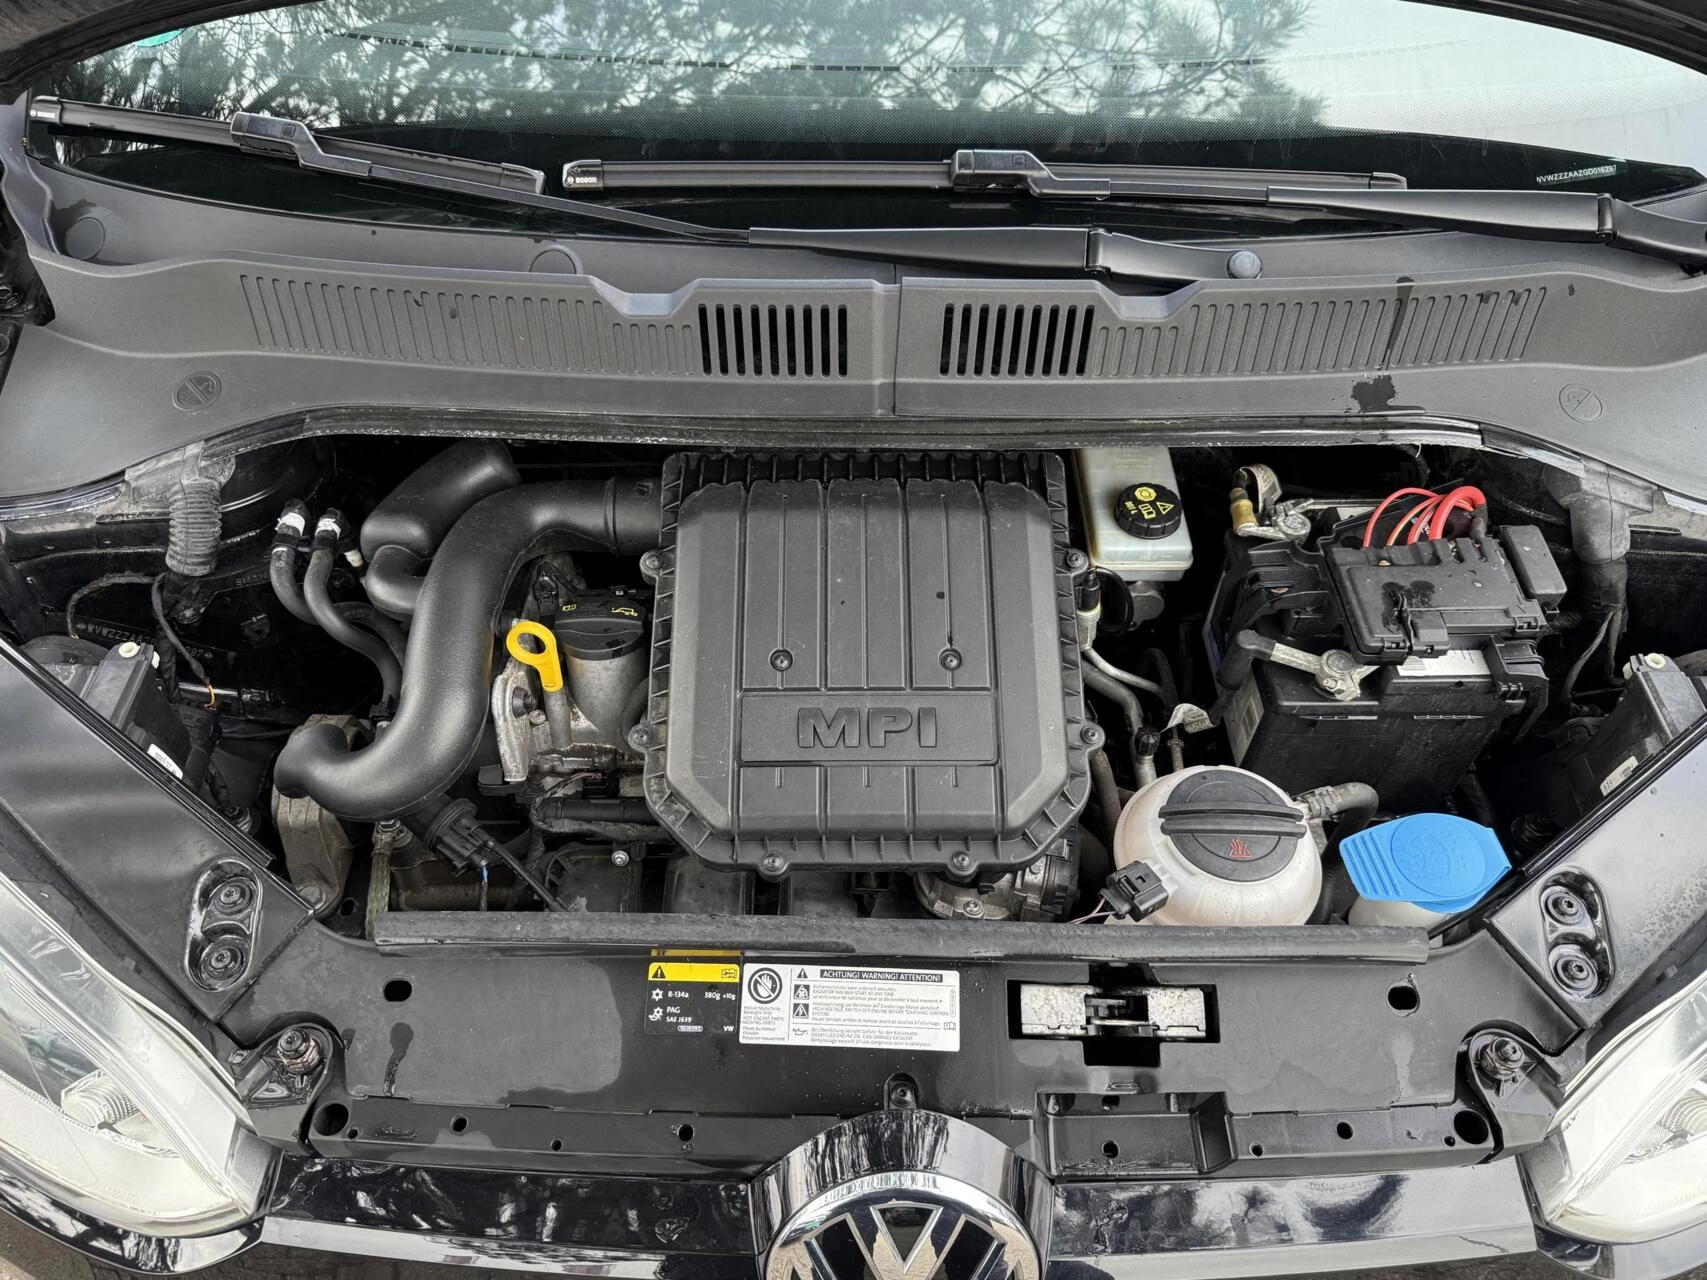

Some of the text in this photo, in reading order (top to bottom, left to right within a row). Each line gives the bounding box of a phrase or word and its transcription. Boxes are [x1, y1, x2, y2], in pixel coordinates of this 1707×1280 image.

[798, 707, 937, 748] MPI
[822, 970, 940, 982] ACHTUNG! WARNING! ATTENTION!
